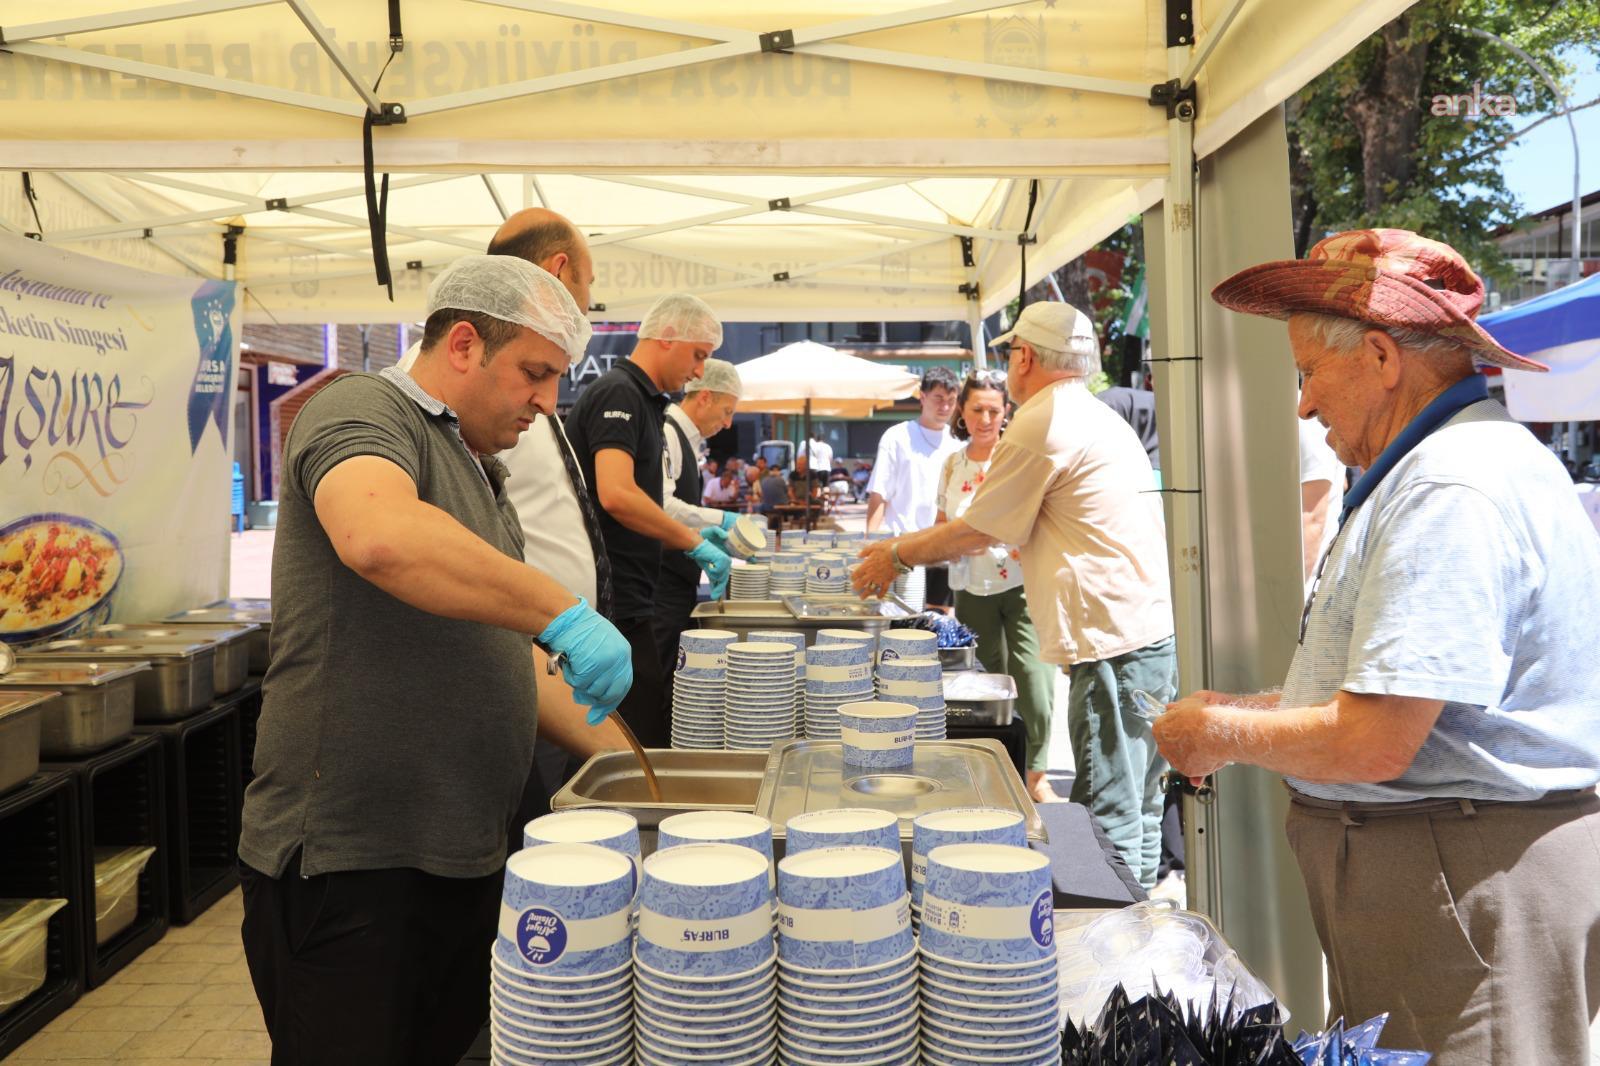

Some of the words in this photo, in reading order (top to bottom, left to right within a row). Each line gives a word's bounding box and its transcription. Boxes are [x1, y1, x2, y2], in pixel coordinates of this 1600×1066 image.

[54, 316, 128, 355] Simgesi
[568, 354, 630, 382] YAT
[525, 921, 558, 937] Afiyet
[683, 928, 730, 942] BURFAŞ
